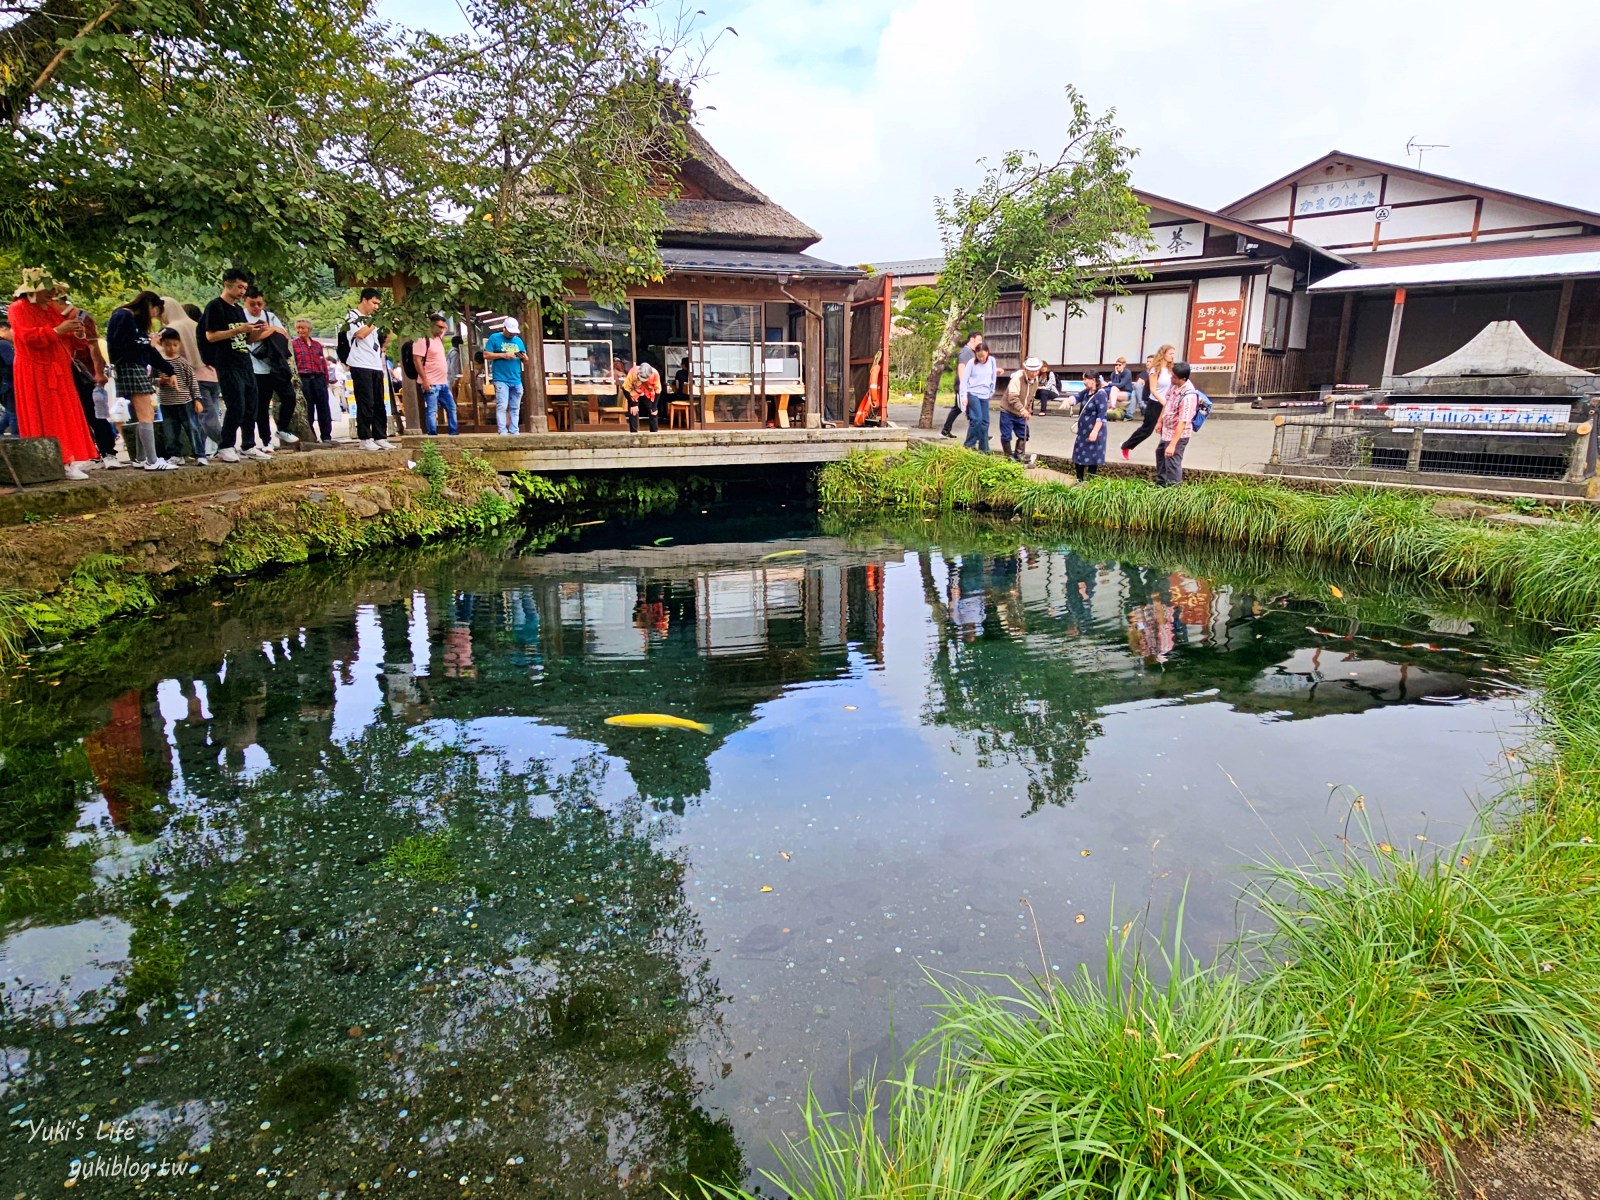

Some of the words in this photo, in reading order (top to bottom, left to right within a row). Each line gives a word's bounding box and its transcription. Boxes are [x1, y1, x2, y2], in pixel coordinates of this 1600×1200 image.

[1300, 190, 1375, 212] かまのはた
[1197, 306, 1237, 318] 忍野八海
[1195, 328, 1236, 341] コーヒー
